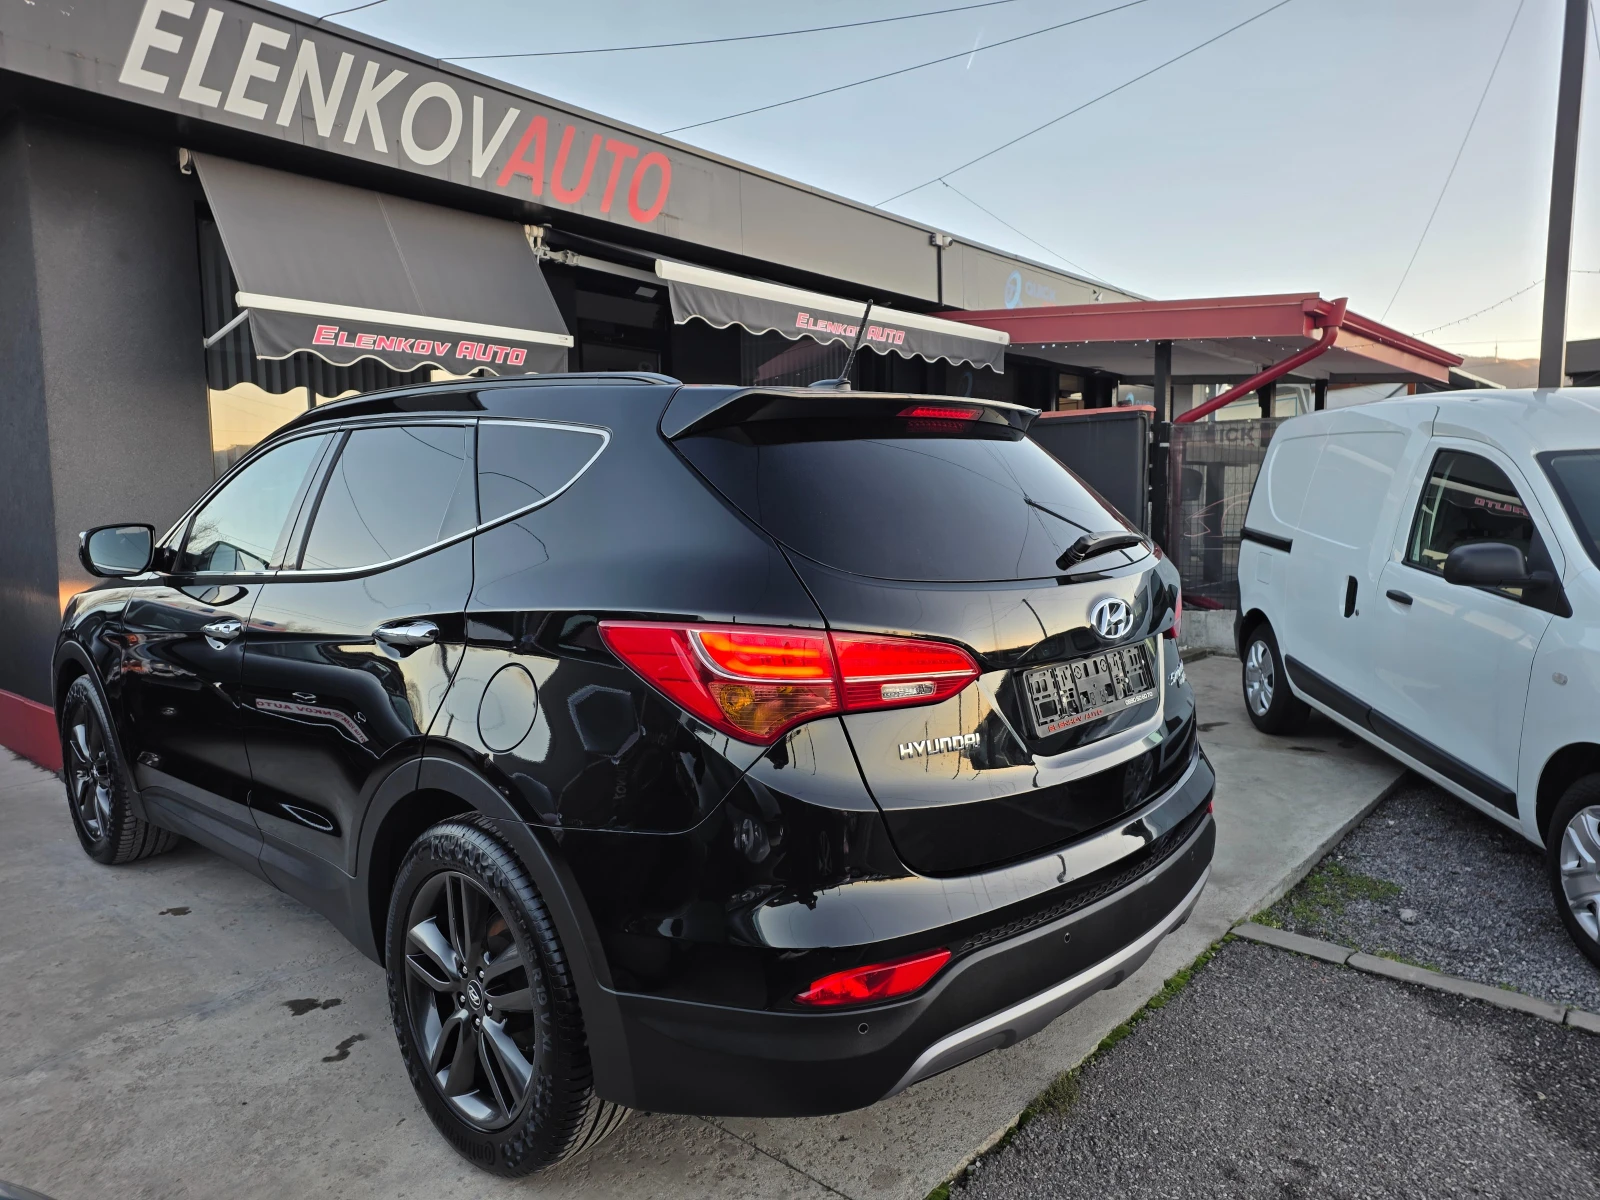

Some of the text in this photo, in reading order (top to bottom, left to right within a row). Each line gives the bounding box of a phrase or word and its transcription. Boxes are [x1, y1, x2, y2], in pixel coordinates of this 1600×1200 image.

[312, 324, 527, 366] ELENKOV AUTO
[796, 312, 905, 345] ELENKO AUTO
[899, 732, 981, 760] HYUNDAI
